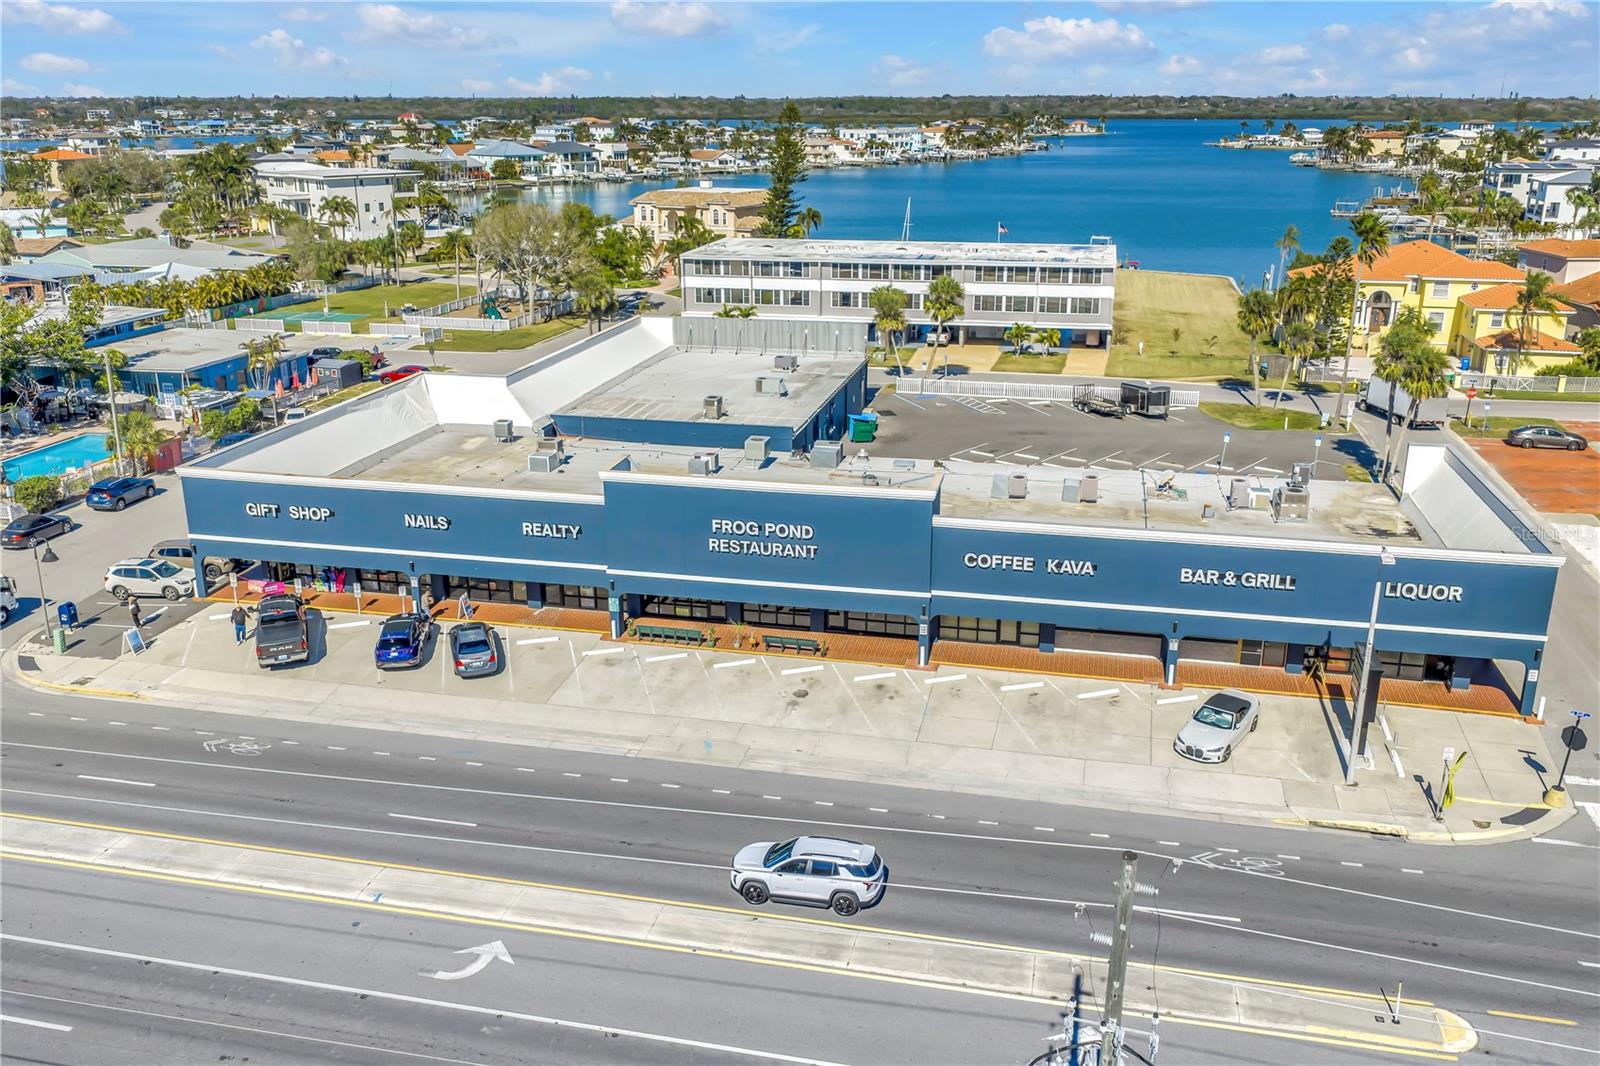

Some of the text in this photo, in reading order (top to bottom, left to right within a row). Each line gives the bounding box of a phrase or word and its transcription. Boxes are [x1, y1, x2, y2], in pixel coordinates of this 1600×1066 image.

[245, 502, 332, 522] GIFT SHOP
[404, 513, 448, 531] NAILS
[522, 521, 582, 540] REALTY
[711, 519, 814, 541] FROG POND
[708, 538, 818, 559] RESTAURANT
[964, 553, 1094, 576] COFFEE KAVA
[1180, 568, 1295, 591] BAR & GRILL
[1385, 581, 1463, 602] LIQUOR
